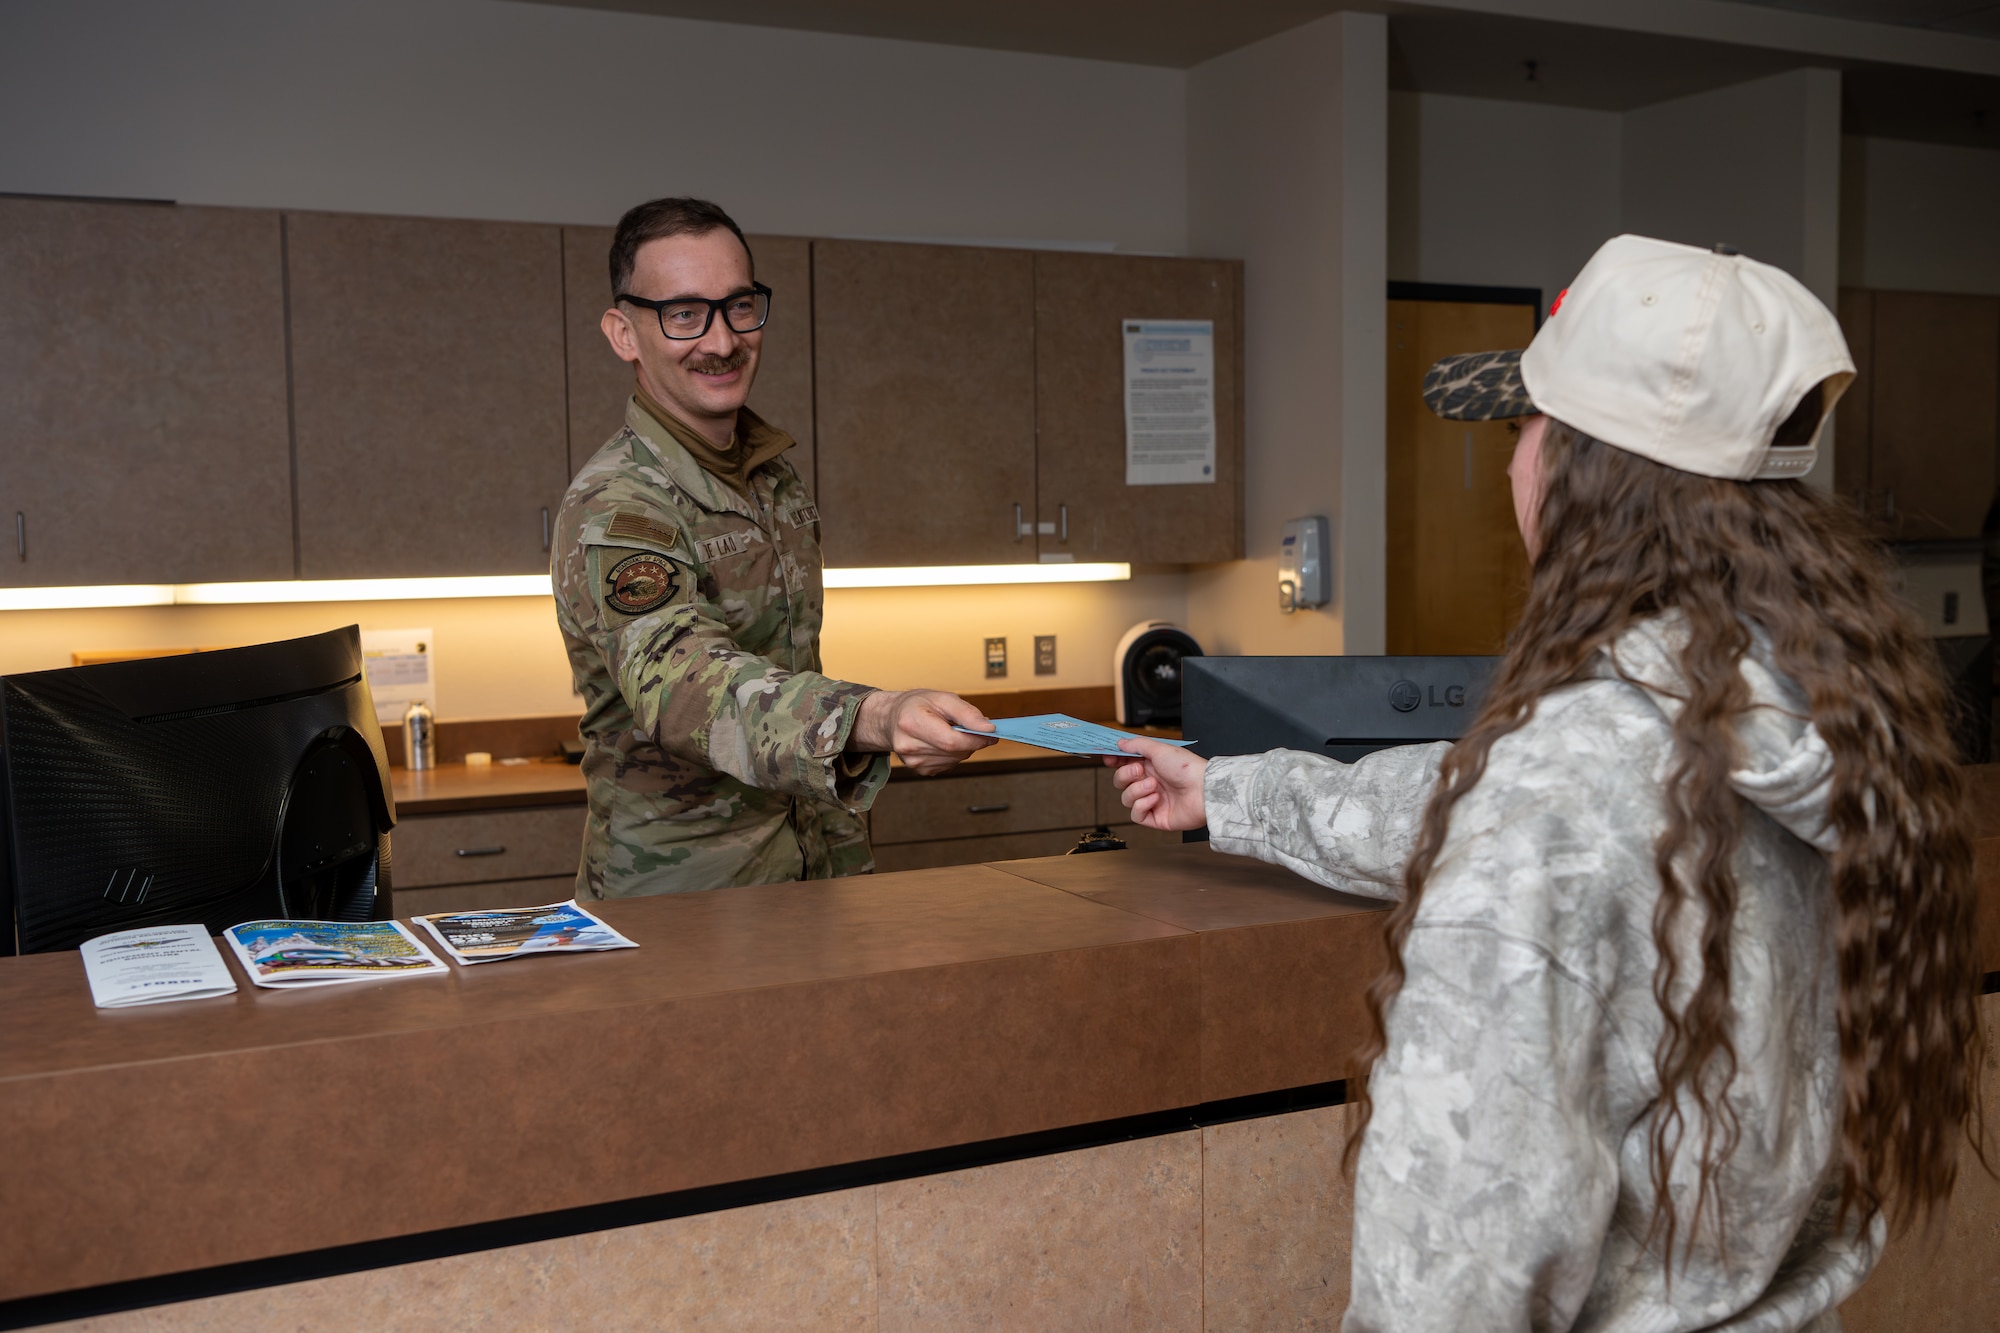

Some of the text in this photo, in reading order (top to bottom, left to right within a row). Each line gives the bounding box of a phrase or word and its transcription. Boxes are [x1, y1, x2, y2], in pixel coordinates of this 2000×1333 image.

[615, 556, 642, 573] GUARDIANS
[653, 556, 669, 568] SPACE
[1428, 684, 1465, 707] LG
